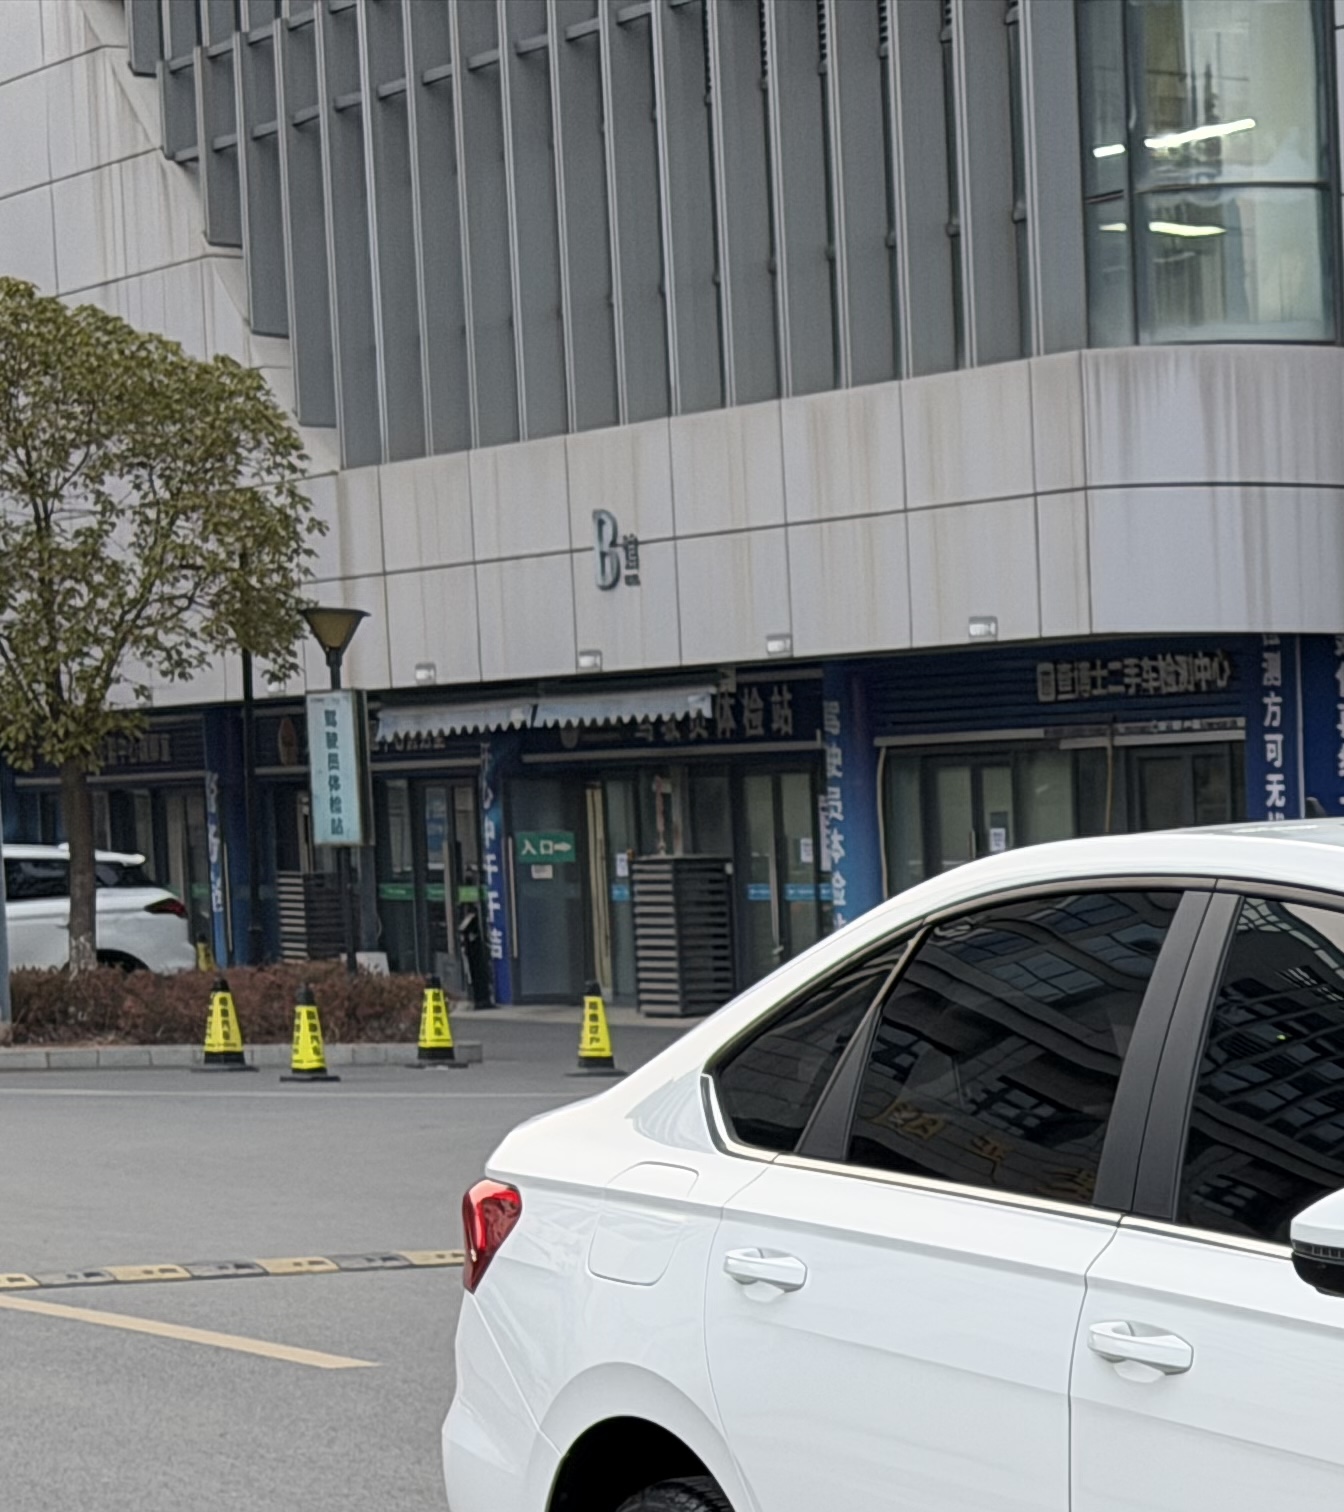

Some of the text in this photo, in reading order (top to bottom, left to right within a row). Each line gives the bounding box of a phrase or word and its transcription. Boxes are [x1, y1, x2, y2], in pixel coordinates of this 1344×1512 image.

[1261, 633, 1287, 821] 测方可无
[521, 839, 554, 856] 入口
